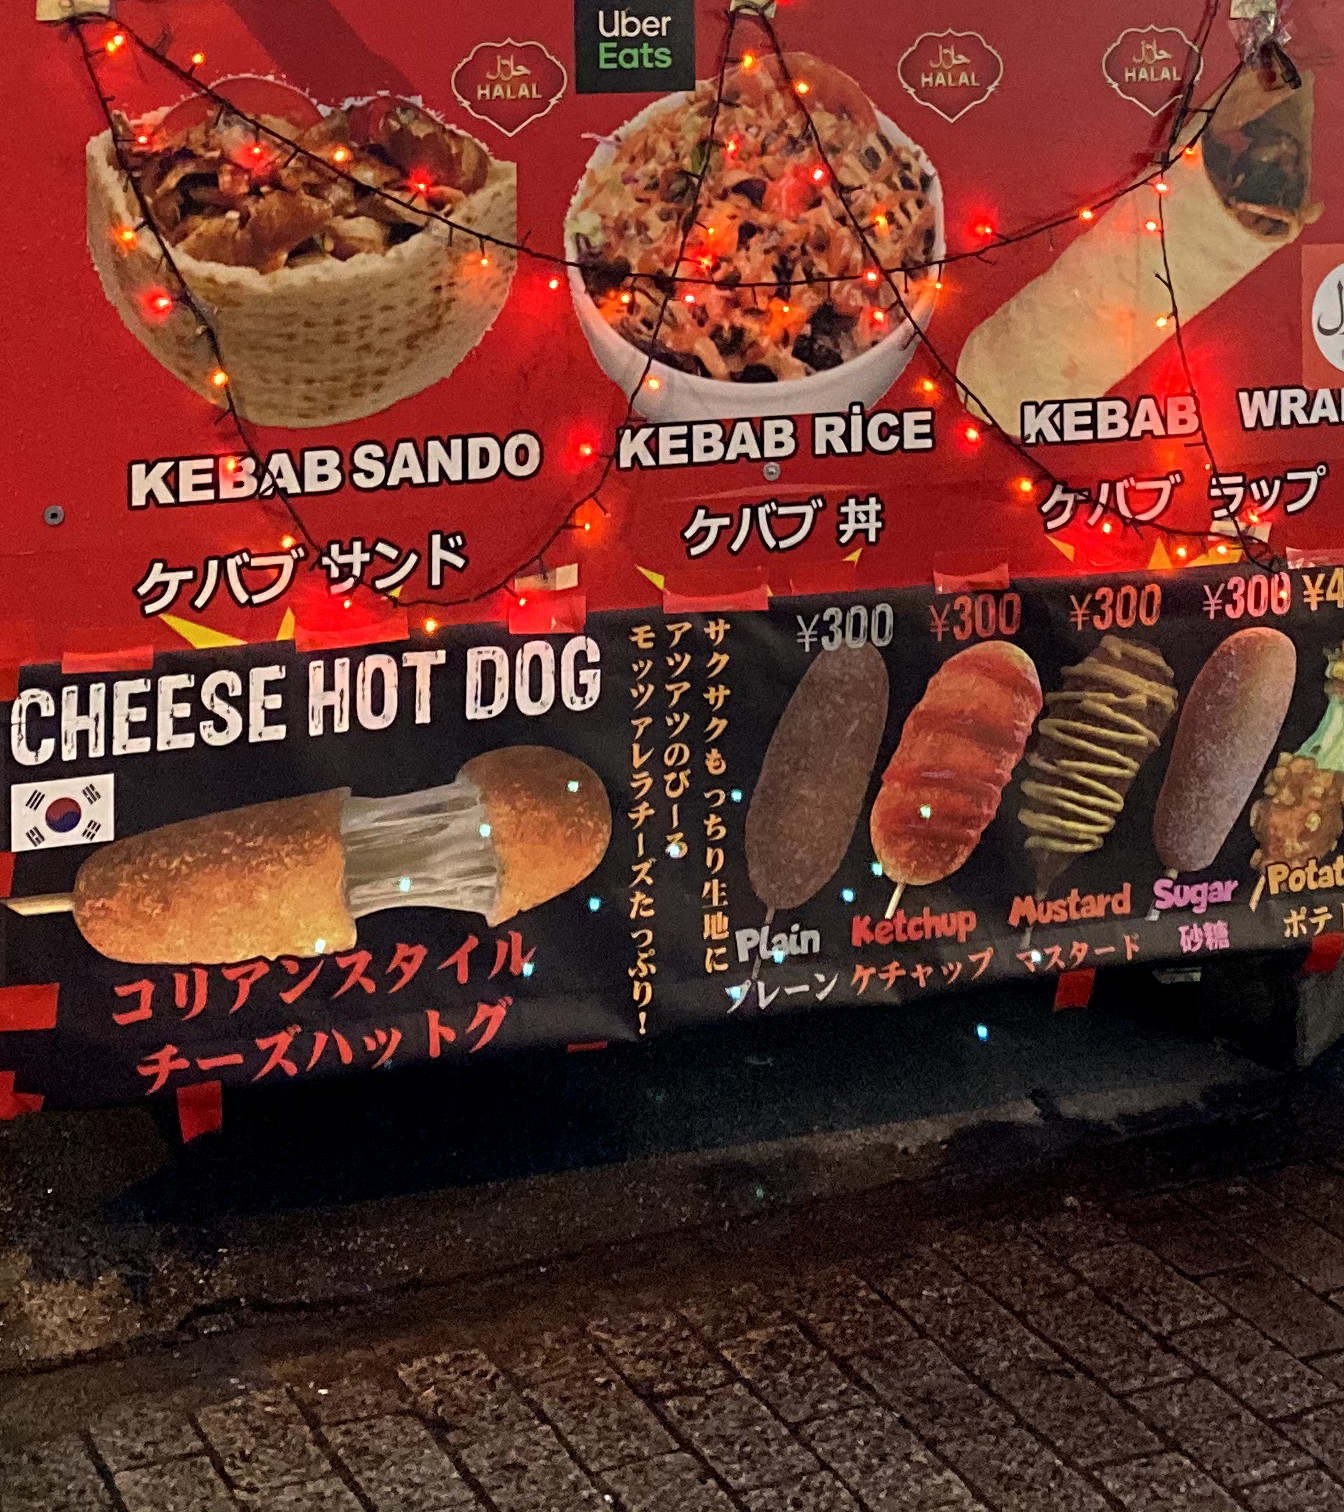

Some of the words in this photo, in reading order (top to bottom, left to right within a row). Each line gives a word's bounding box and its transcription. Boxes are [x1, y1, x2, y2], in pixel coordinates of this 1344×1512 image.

[598, 10, 672, 37] Uber
[598, 41, 673, 69] Eats
[920, 69, 981, 89] HALAL
[1123, 64, 1182, 84] HALAL
[476, 82, 543, 101] HALAL
[618, 414, 795, 469] KEBAB
[1020, 395, 1199, 443] KEBAB
[129, 449, 342, 506] KEBAB
[352, 431, 542, 487] SANDO
[1039, 473, 1182, 530] ケバブ
[1209, 464, 1328, 517] ラップ
[683, 497, 825, 556] ケバブ
[838, 496, 883, 544] 丼
[137, 545, 305, 615] ケバブ
[321, 530, 469, 594] サンド
[928, 592, 1022, 643] ¥300
[1067, 582, 1163, 632] ¥300
[1200, 574, 1292, 621] ¥300
[794, 602, 894, 654] ¥300
[11, 663, 287, 767] CHEESE
[306, 648, 448, 737] HOT
[465, 635, 604, 721] DOG
[700, 618, 731, 975] サクサクもっちり生地に
[1008, 882, 1132, 927] Mustard
[1153, 876, 1239, 912] Sugar
[734, 923, 822, 964] Plain
[851, 907, 977, 948] Ketchup
[1179, 921, 1231, 954] 砂糖
[850, 946, 995, 995] ケチャップ
[1016, 932, 1142, 973] マスタード
[110, 928, 538, 1027] コリアンスタイル
[723, 971, 840, 1016] プレーン
[135, 995, 516, 1097] チーズハットグ
